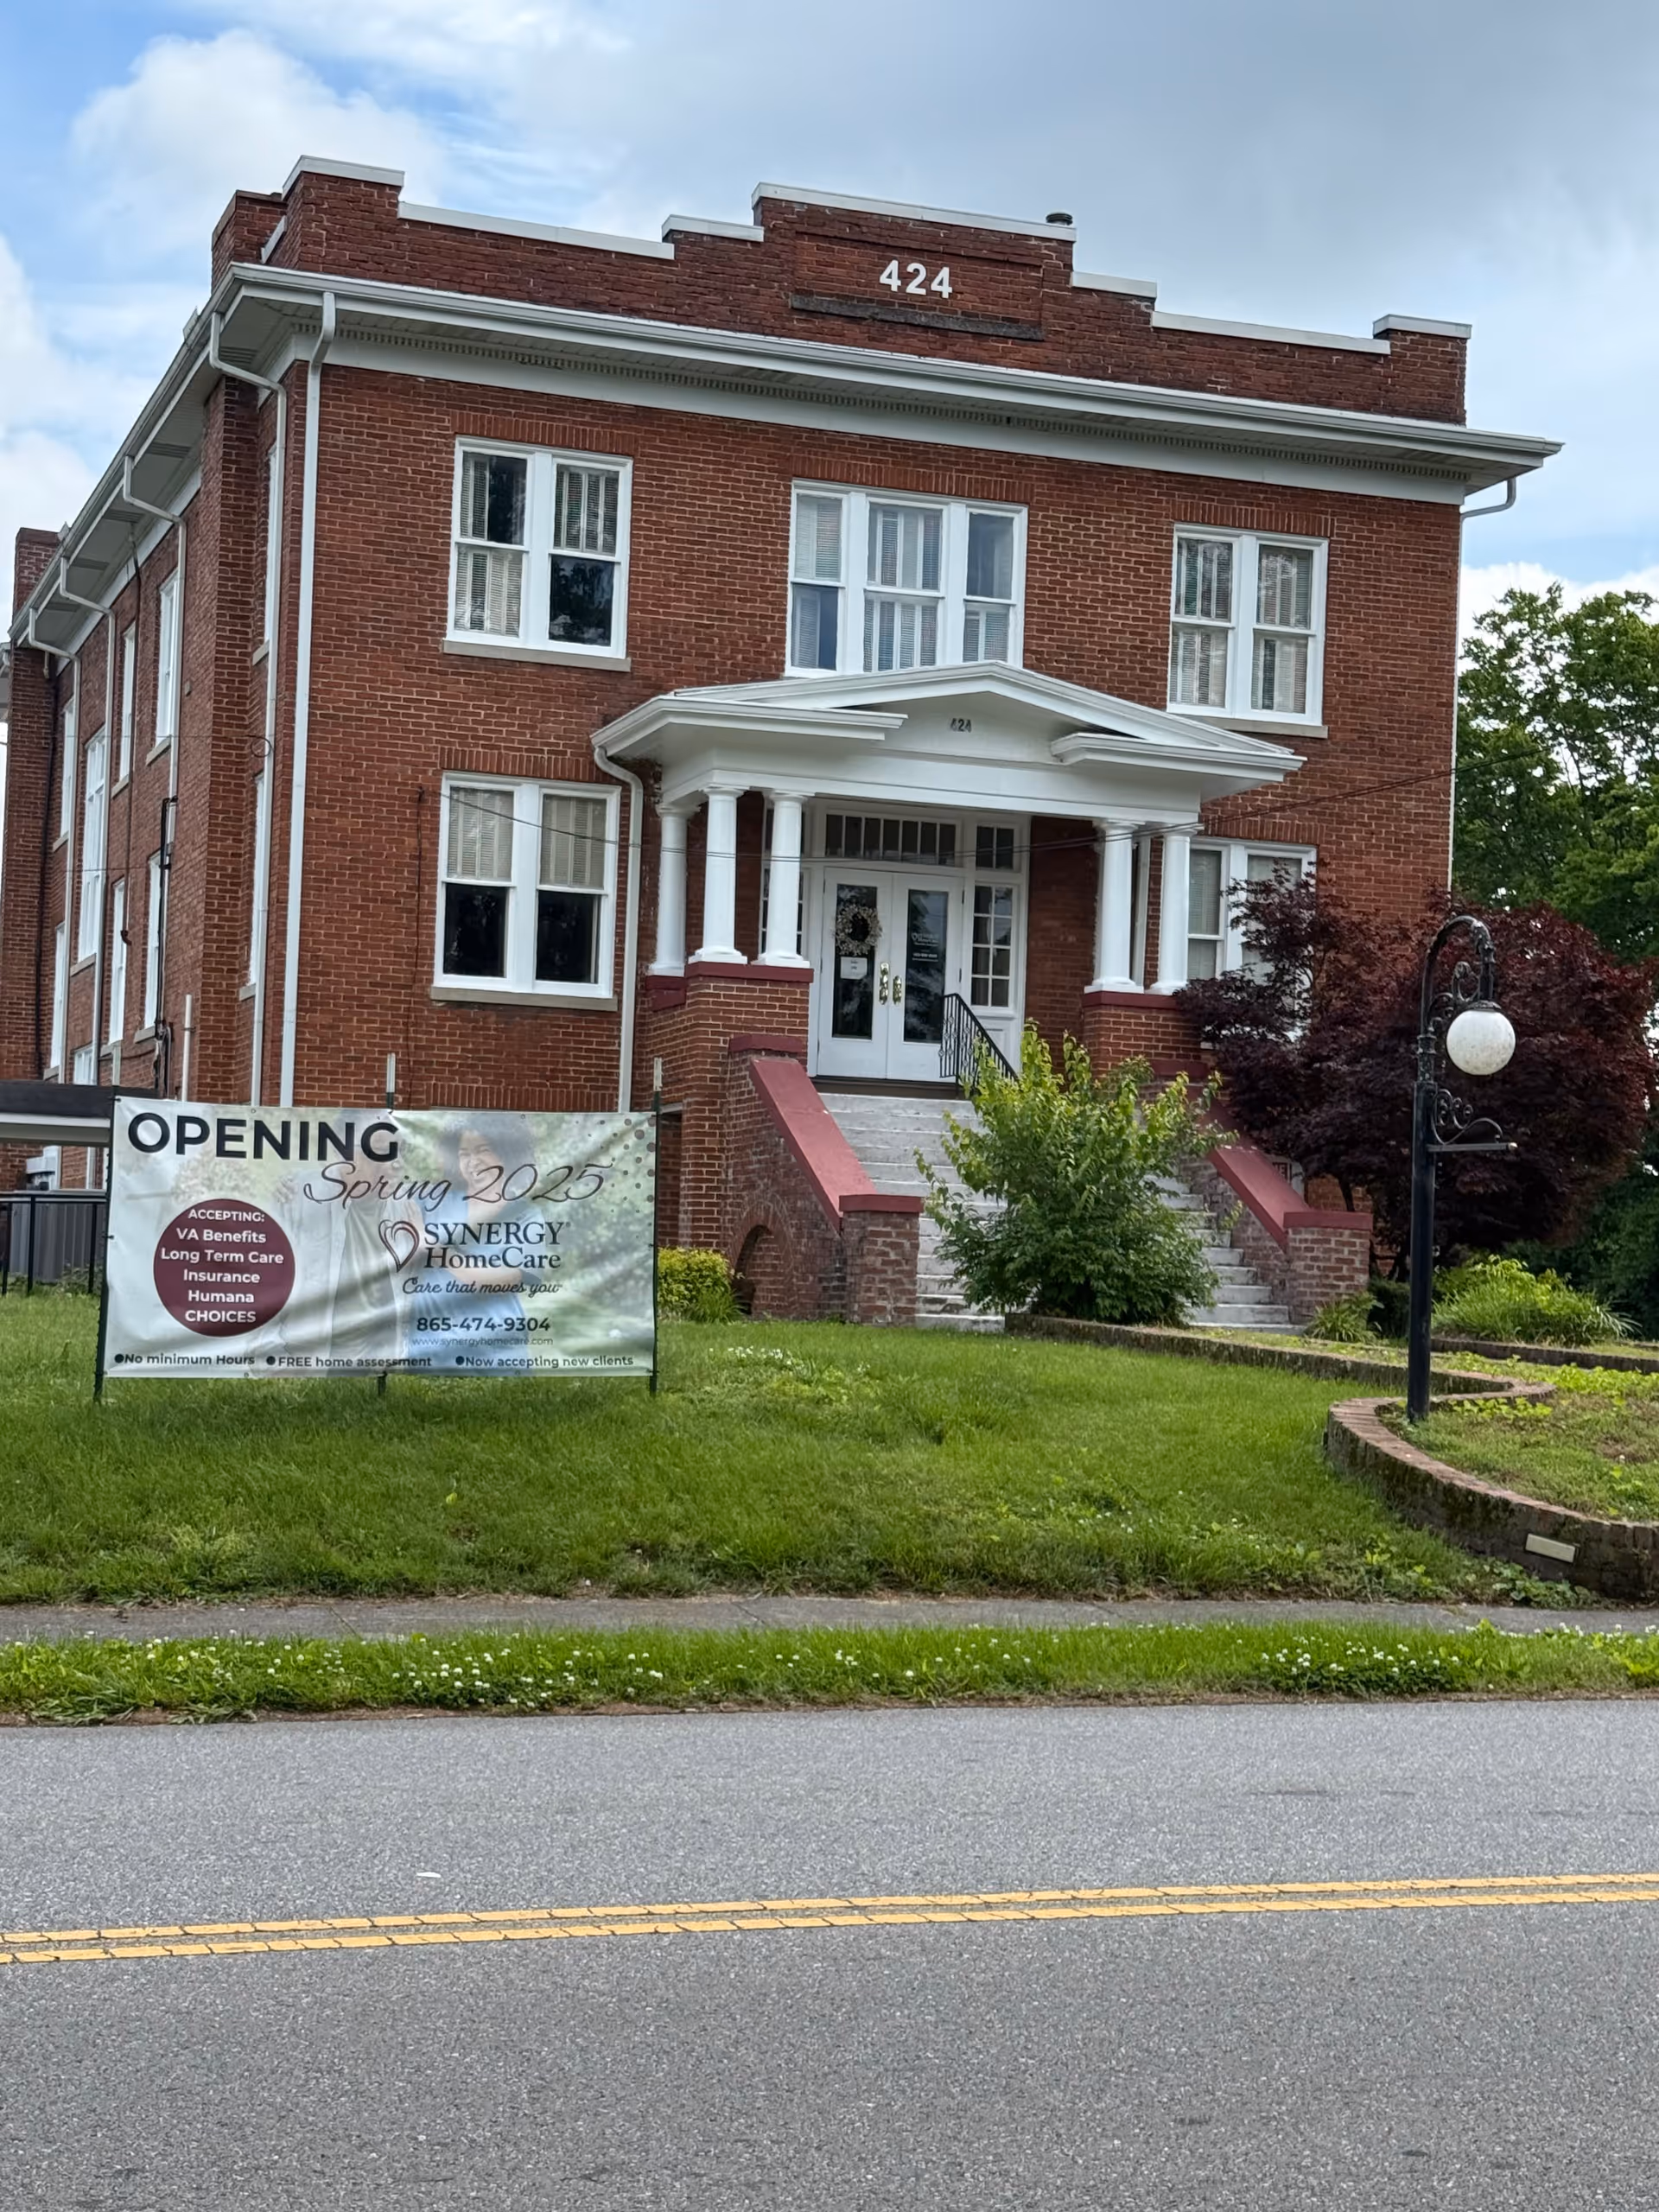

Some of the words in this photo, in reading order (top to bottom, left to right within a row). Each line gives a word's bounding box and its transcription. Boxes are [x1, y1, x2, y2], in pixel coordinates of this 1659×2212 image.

[879, 259, 952, 299] 424
[950, 718, 972, 733] 424
[128, 1112, 399, 1162] OPENING
[303, 1161, 453, 1212] Spring
[463, 1163, 613, 1204] 2025
[188, 1209, 265, 1223] ACCEPTING:
[176, 1228, 199, 1241] VA
[203, 1229, 267, 1243] Benefits
[424, 1222, 564, 1245] SYNERGY
[161, 1247, 200, 1264] Long
[204, 1249, 245, 1262] Term
[248, 1251, 284, 1264] Care
[423, 1246, 561, 1269] HomeCare
[183, 1268, 261, 1283] Insurance
[403, 1276, 442, 1294] Care
[446, 1281, 476, 1294] that
[480, 1283, 525, 1294] moves
[530, 1283, 559, 1298] you
[188, 1289, 255, 1303] Humana
[185, 1309, 257, 1323] CHOICES
[416, 1317, 550, 1332] 865-474-9304
[412, 1337, 554, 1347] www.synergyhomecare.com
[124, 1353, 143, 1364] No
[147, 1352, 212, 1365] minimum
[216, 1354, 256, 1365] Hours
[278, 1357, 312, 1367] FREE
[315, 1356, 353, 1368] home
[357, 1357, 432, 1368] assessment
[466, 1356, 494, 1367] Now
[498, 1356, 559, 1369] accepting
[563, 1358, 589, 1367] new
[593, 1355, 634, 1366] clients
